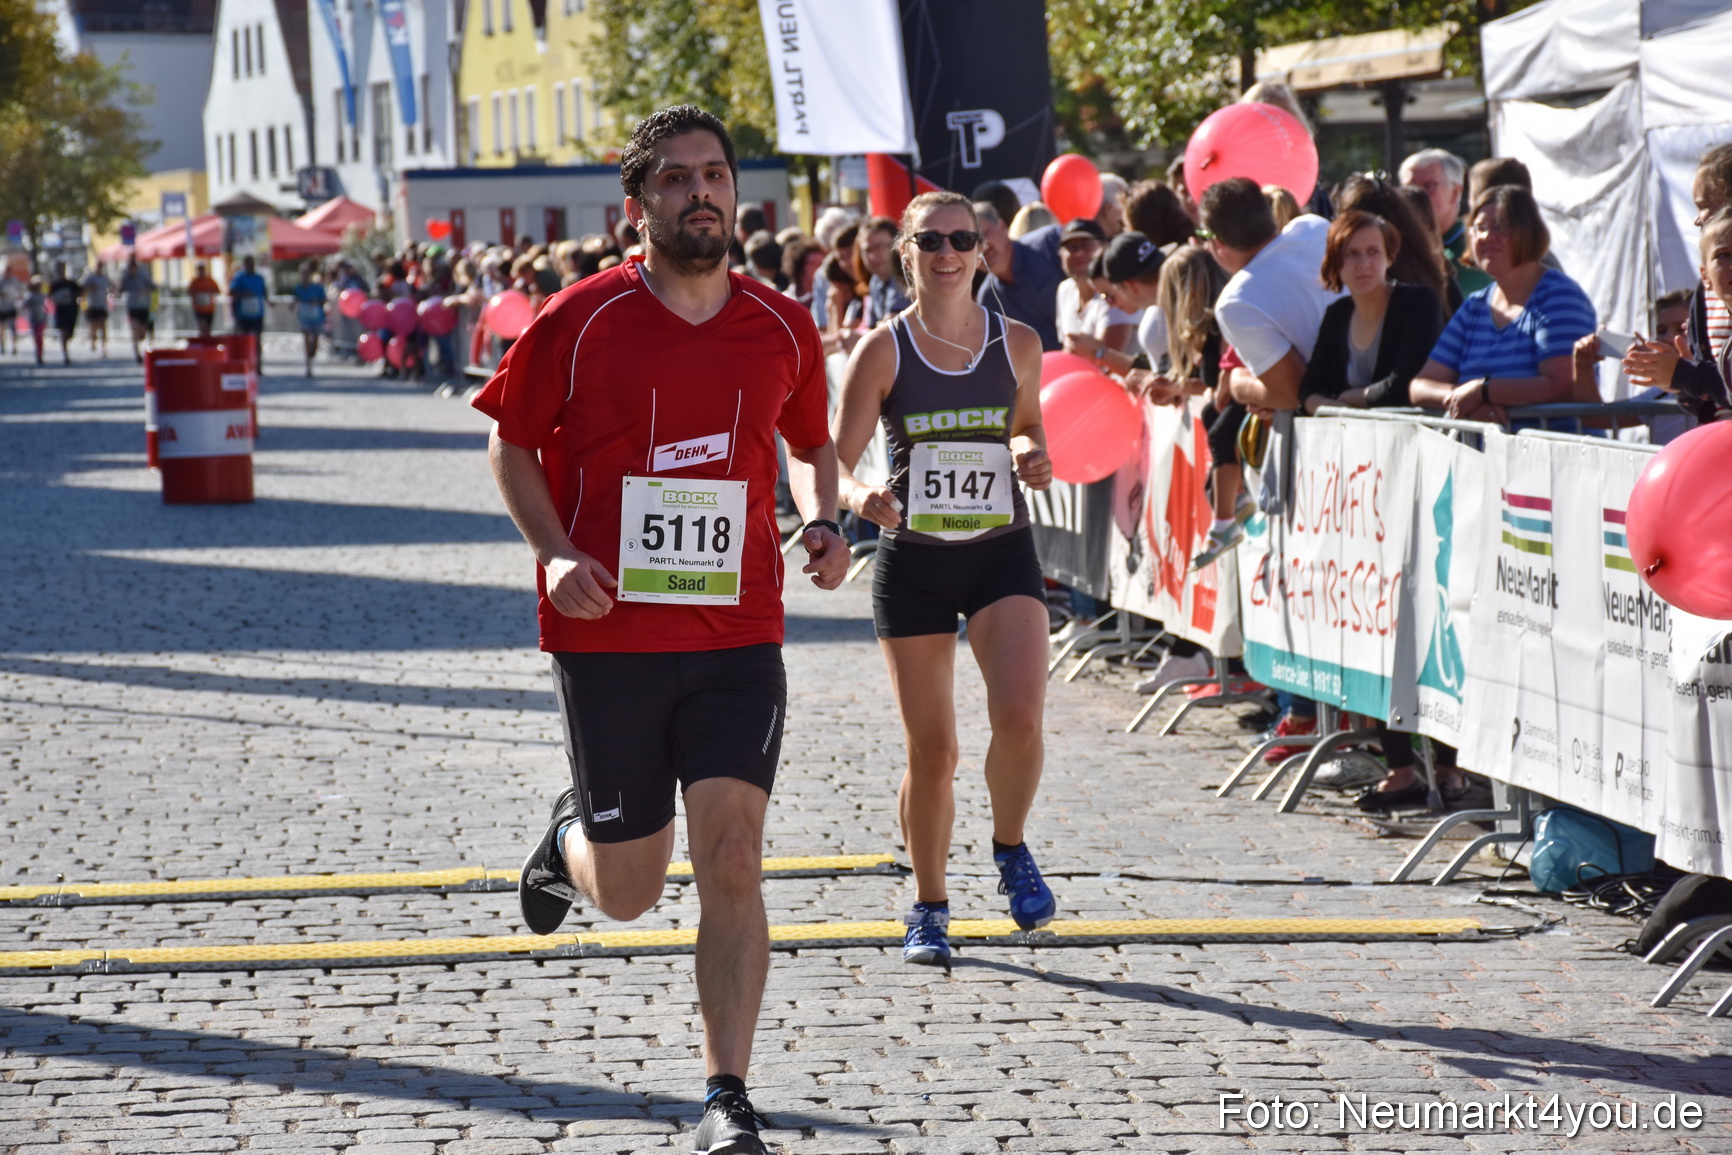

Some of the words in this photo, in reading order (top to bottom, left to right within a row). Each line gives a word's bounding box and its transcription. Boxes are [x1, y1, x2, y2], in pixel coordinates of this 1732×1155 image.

[903, 407, 1009, 435] BOCK
[675, 444, 709, 461] DEHN
[938, 451, 984, 463] BOCK
[924, 470, 996, 500] 5147
[663, 490, 718, 505] BOCK
[641, 513, 731, 554] 5118
[649, 556, 677, 566] PARTL
[678, 557, 715, 567] Neumarkt
[667, 574, 706, 591] Saad
